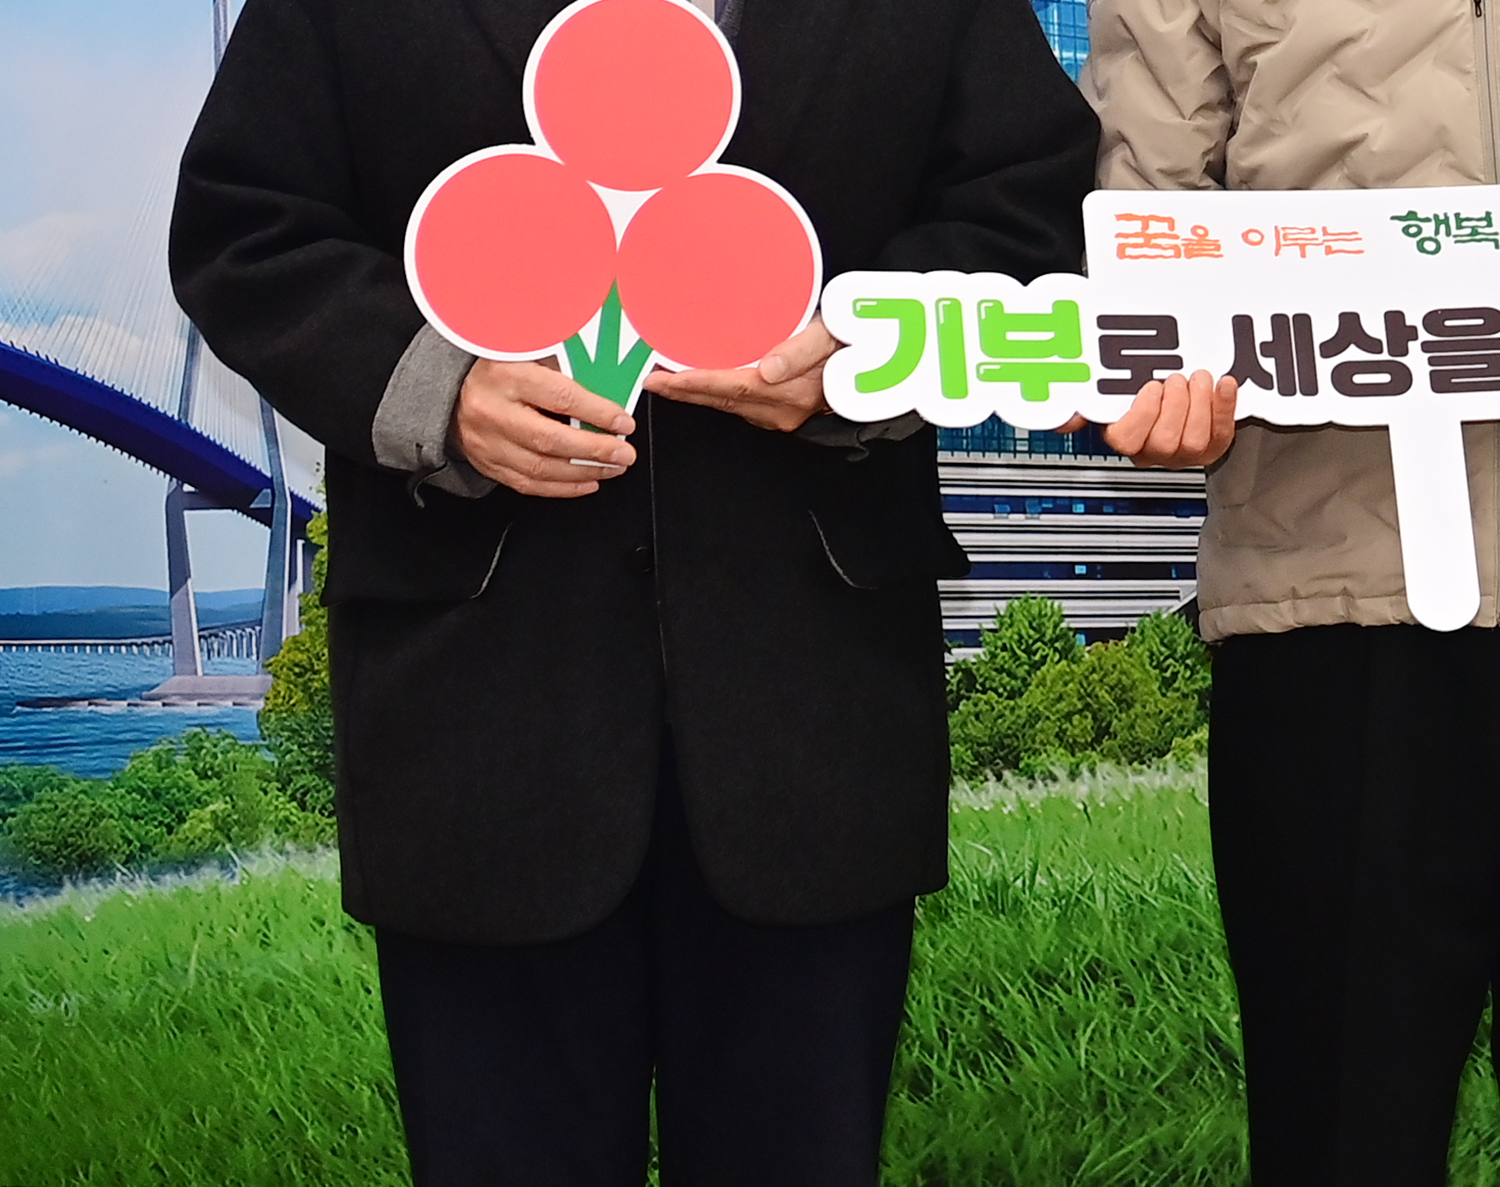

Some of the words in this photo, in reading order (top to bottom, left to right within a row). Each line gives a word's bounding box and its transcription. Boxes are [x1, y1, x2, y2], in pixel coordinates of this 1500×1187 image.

[1114, 213, 1225, 260] 꿈을
[1241, 224, 1364, 258] 이루는
[852, 297, 1184, 402] 기부로
